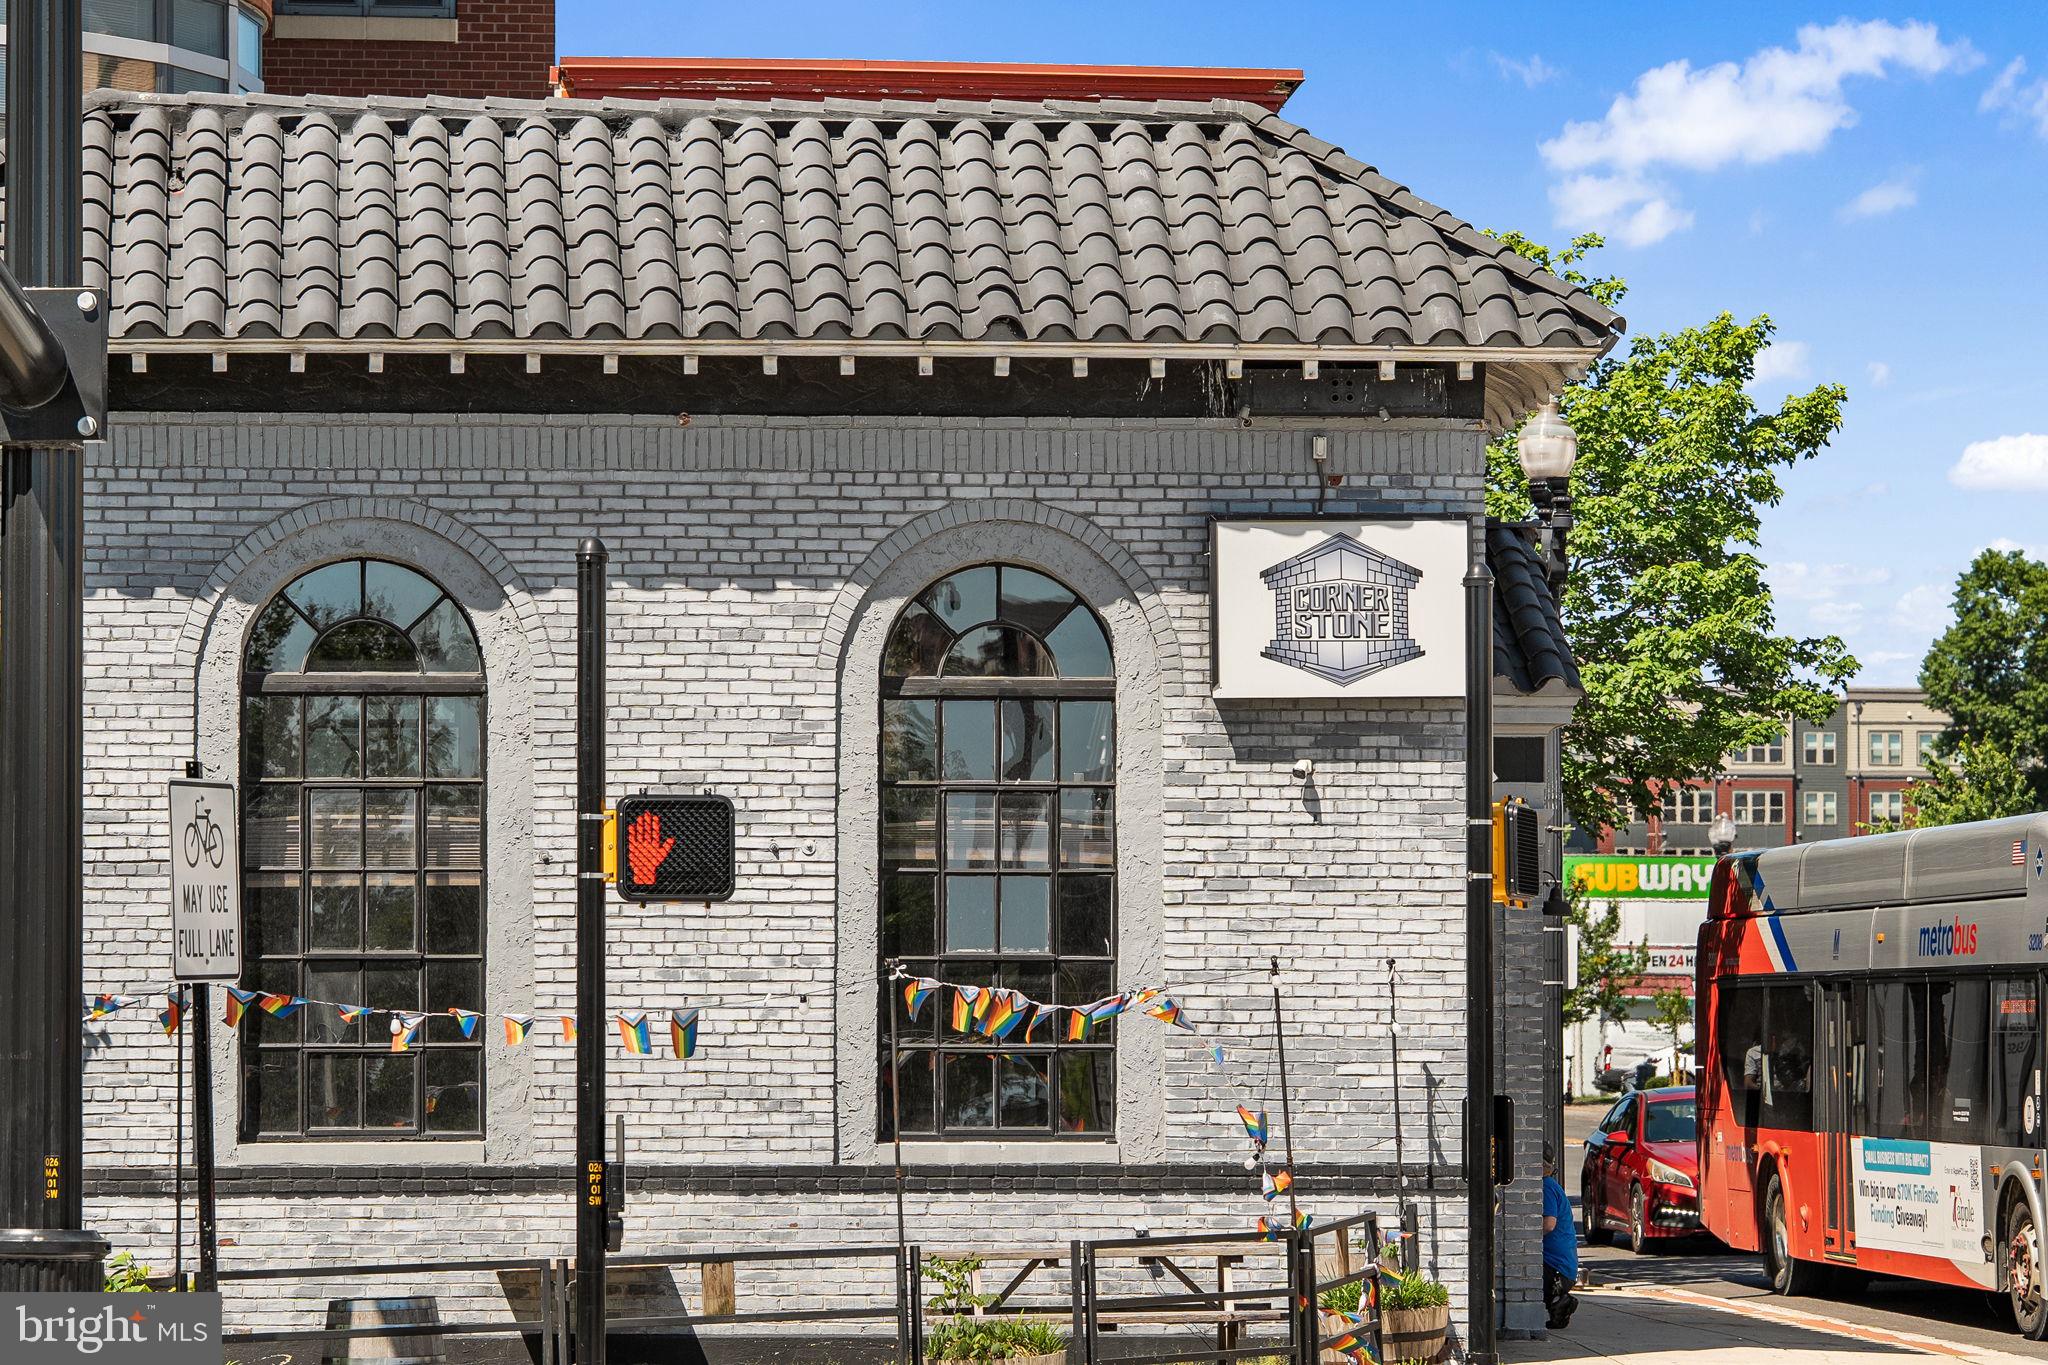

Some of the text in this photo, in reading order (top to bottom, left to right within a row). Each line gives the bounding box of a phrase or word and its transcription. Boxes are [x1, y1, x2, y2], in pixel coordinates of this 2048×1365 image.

[1294, 582, 1389, 612] CORNER
[1294, 611, 1390, 639] STONE
[1574, 863, 1716, 892] SUBWAY
[182, 884, 228, 913] MAY USE
[178, 928, 235, 958] FULL LANE
[1918, 915, 1977, 957] metrobus
[1669, 954, 1684, 967] 24
[45, 1157, 59, 1167] 026
[45, 1168, 59, 1178] MA
[588, 1162, 603, 1173] 026
[589, 1174, 602, 1184] PP
[1859, 1179, 1939, 1204] Win big in our $70K FinTastic
[45, 1189, 59, 1199] SW
[588, 1195, 602, 1206] SW
[1870, 1203, 1928, 1232] Funding Giveaway!
[1956, 1199, 1975, 1228] apple
